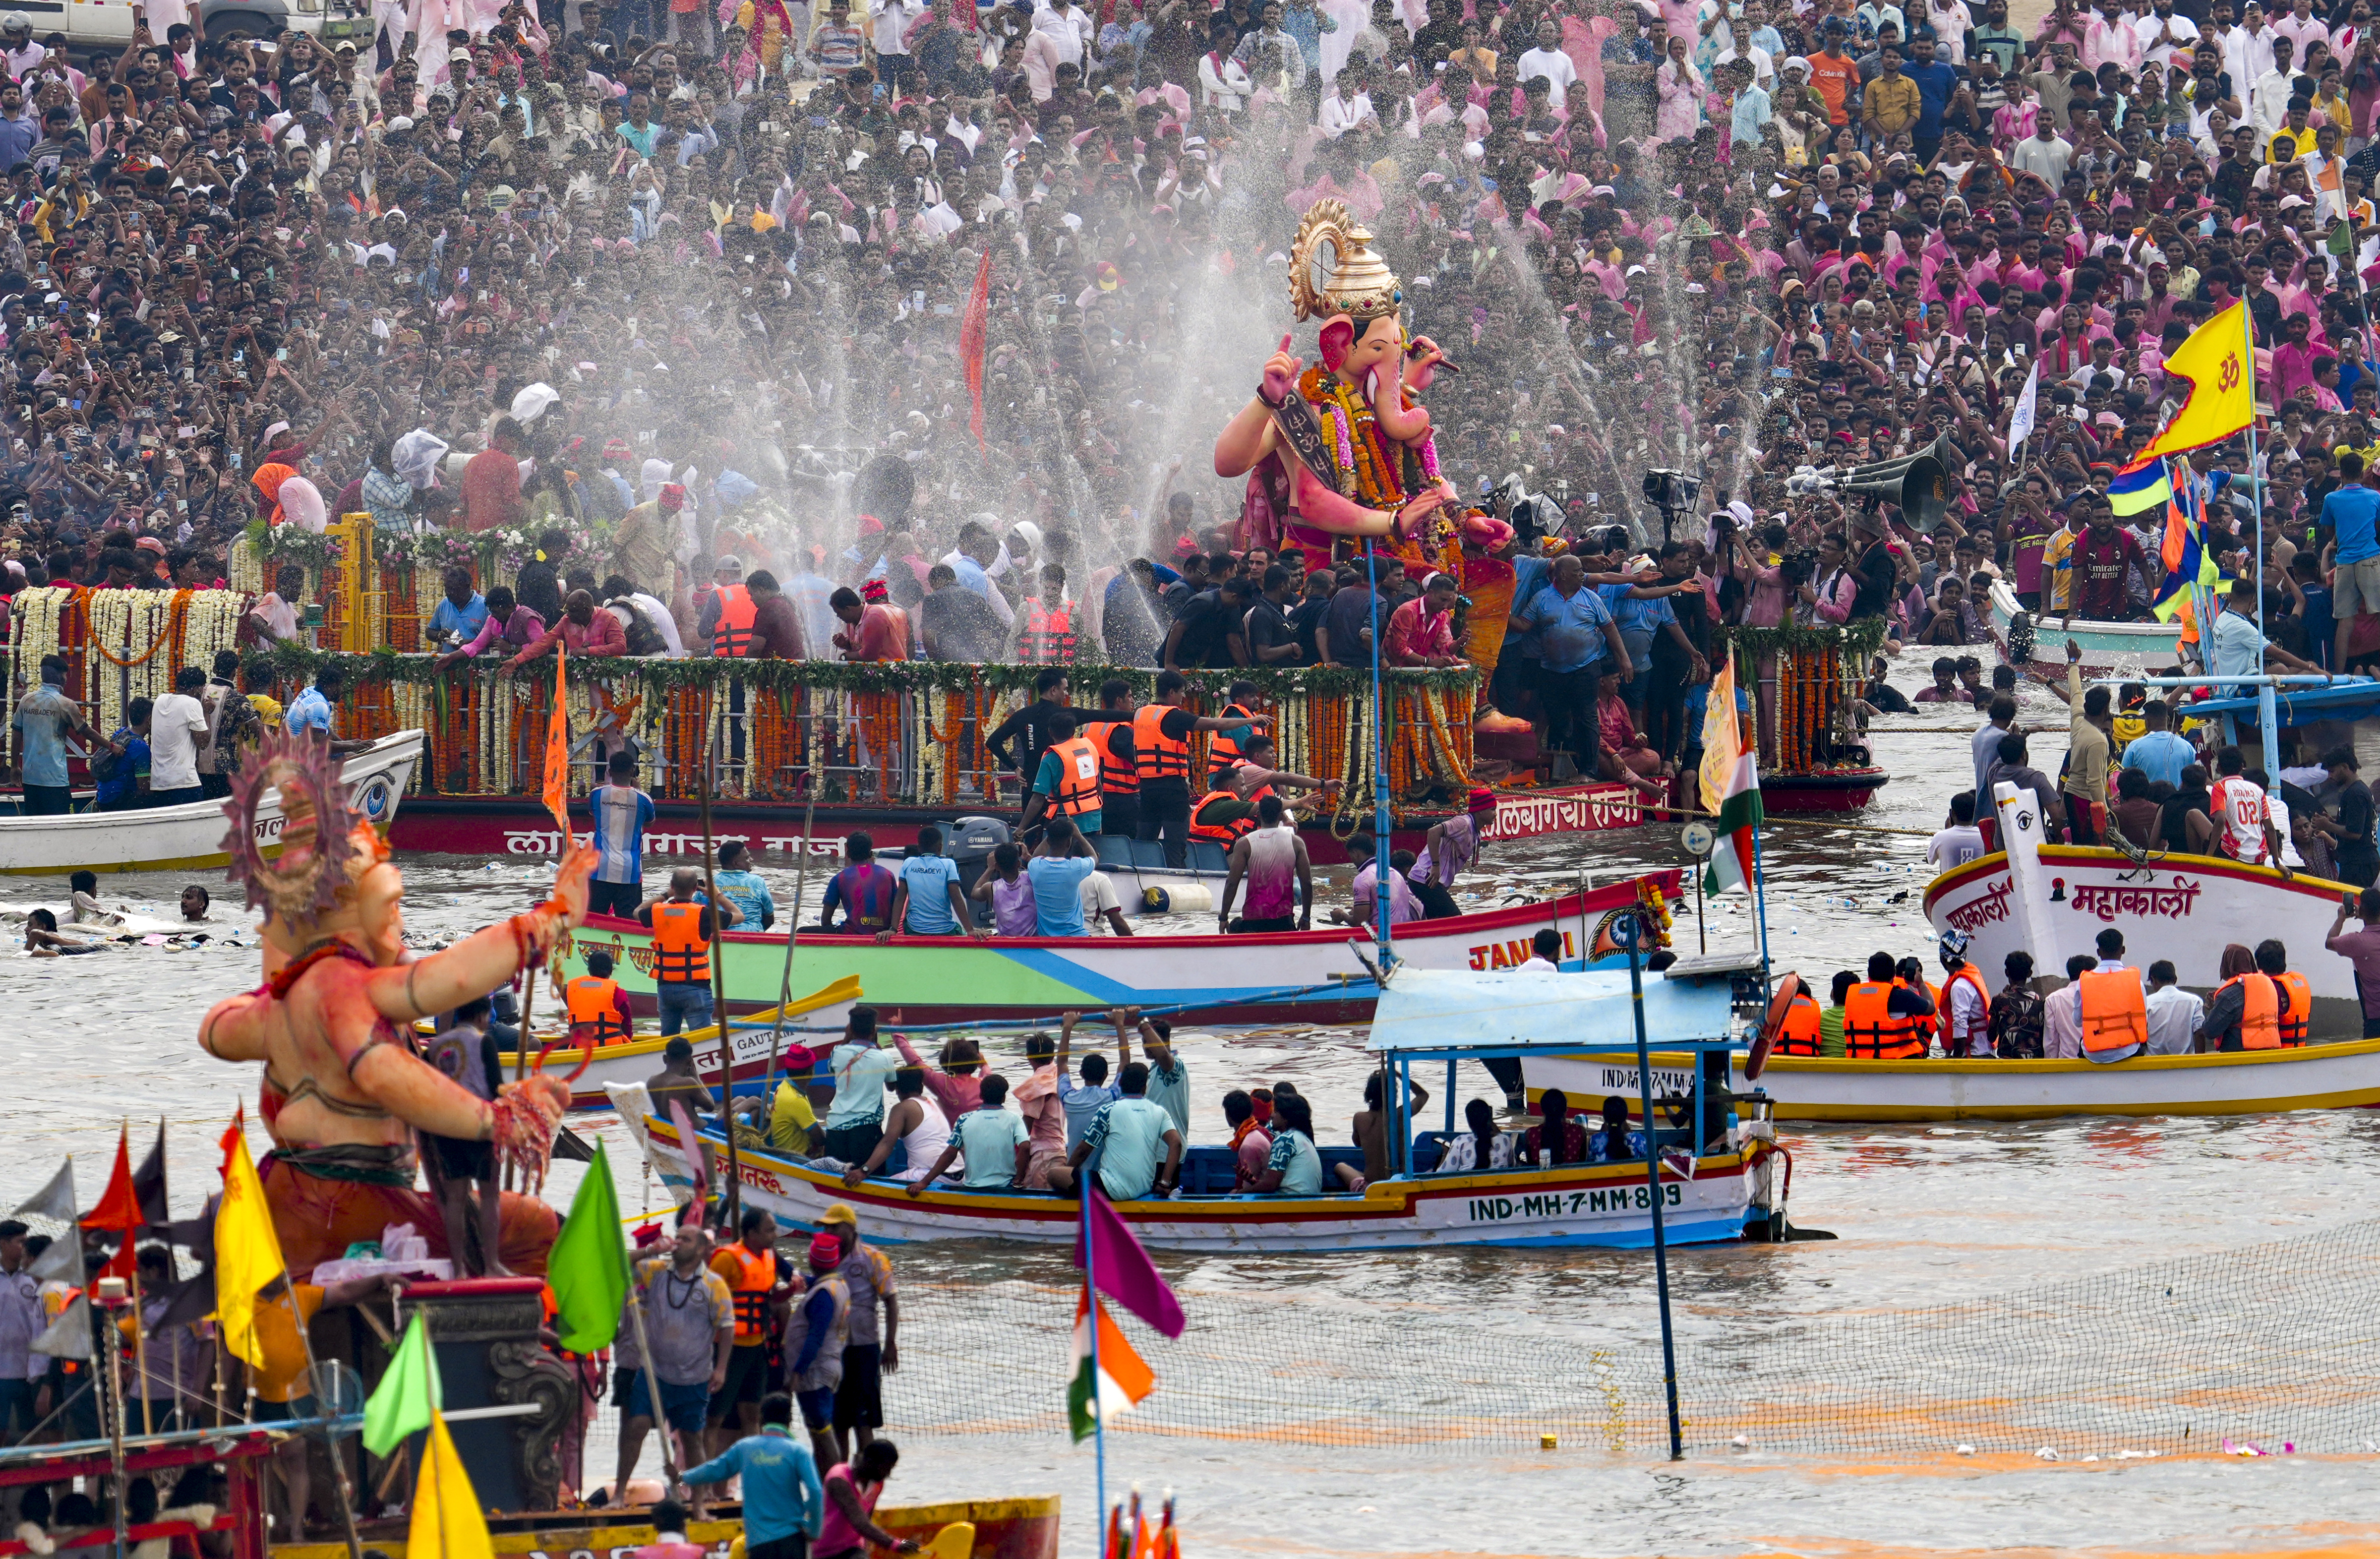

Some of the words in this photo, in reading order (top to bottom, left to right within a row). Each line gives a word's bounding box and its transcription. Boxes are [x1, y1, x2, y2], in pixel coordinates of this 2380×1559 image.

[2087, 564, 2123, 572] Emirates
[23, 708, 56, 717] HARBADEVI
[2237, 800, 2259, 825] 02
[2072, 875, 2201, 922] महाकाली
